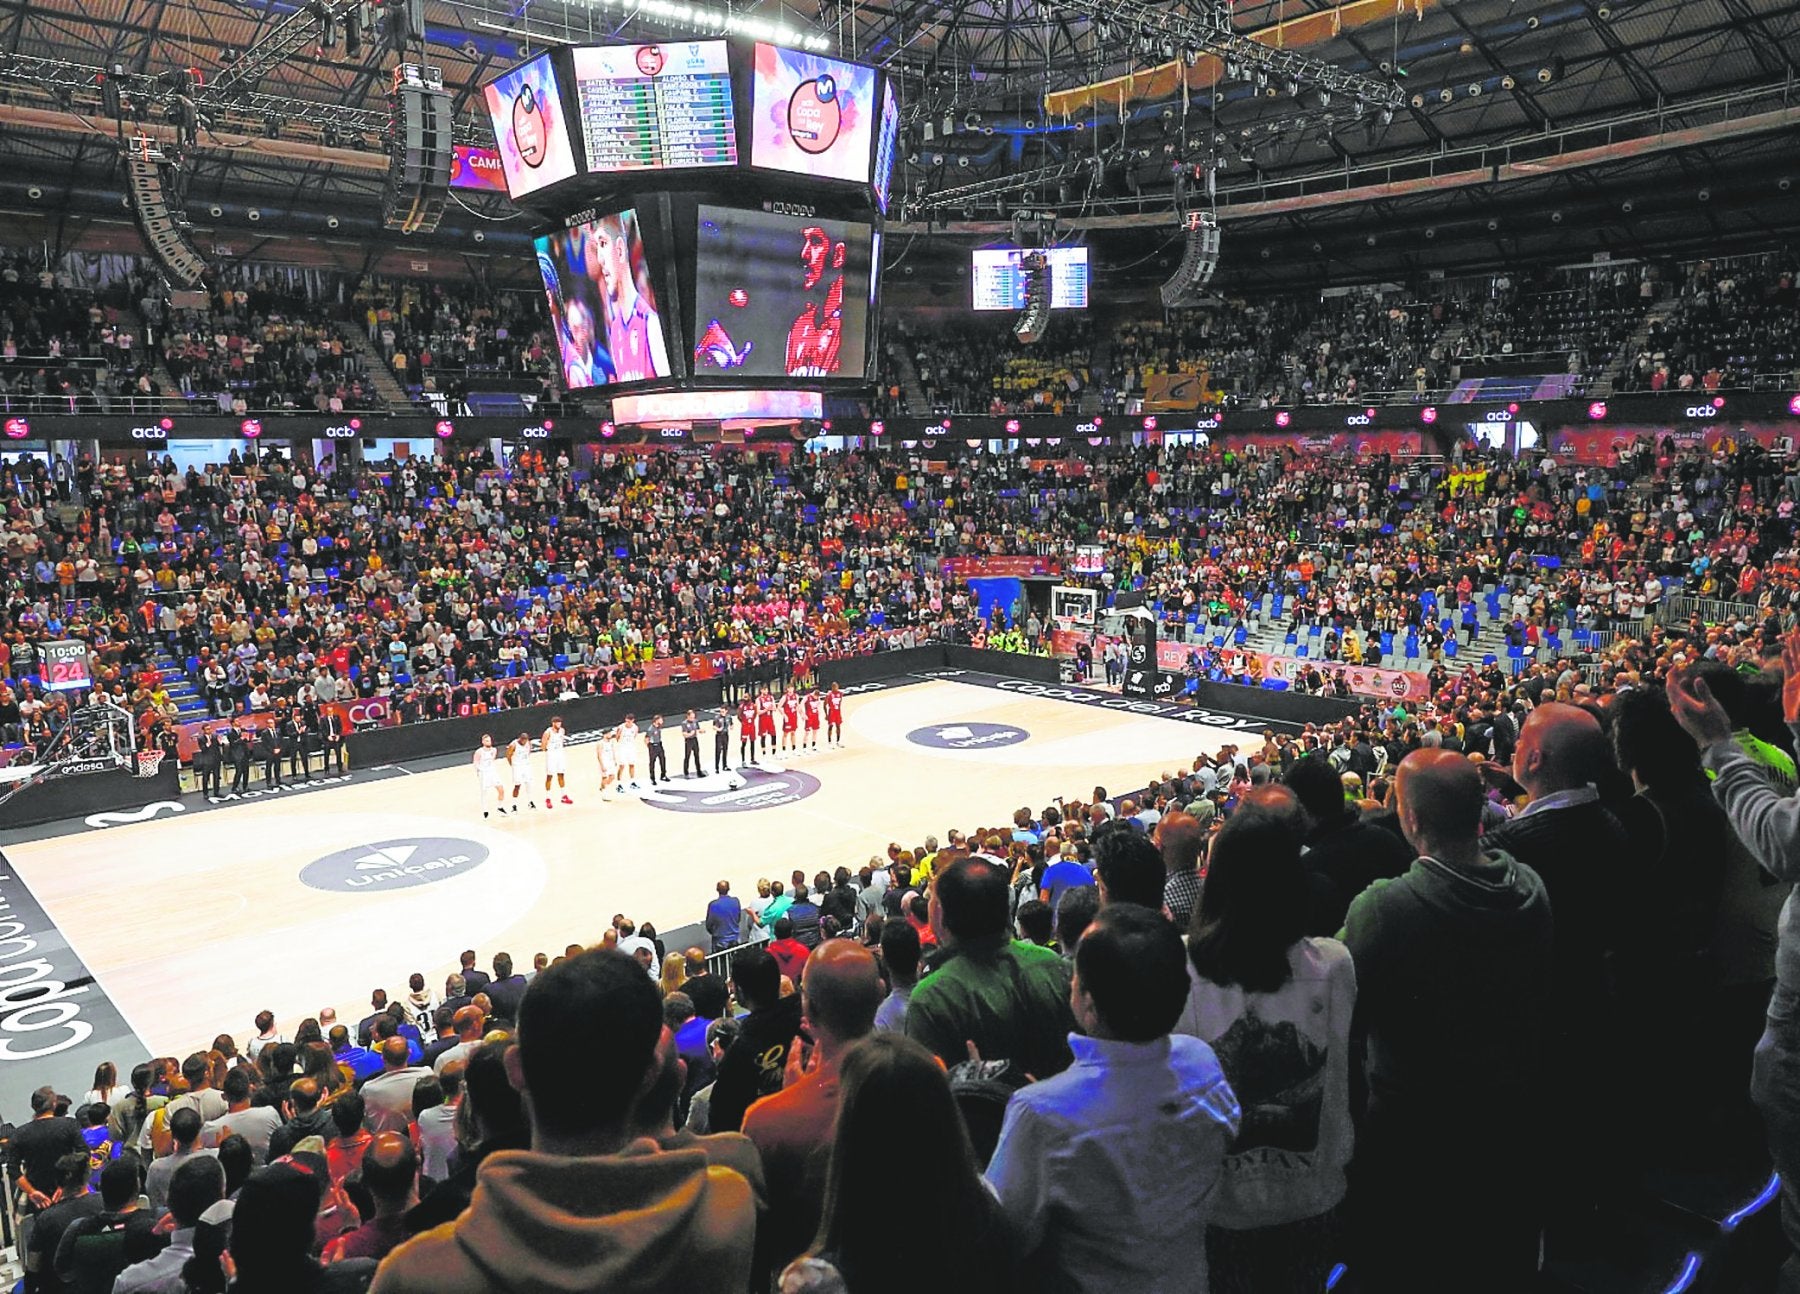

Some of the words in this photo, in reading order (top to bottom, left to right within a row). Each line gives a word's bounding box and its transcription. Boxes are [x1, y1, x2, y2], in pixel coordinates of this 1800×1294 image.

[1486, 410, 1512, 421] acb
[1686, 404, 1716, 418] acb
[1197, 418, 1218, 428] acb
[1347, 415, 1370, 425] acb
[132, 426, 166, 438] acb
[326, 426, 355, 438] acb
[523, 427, 548, 438] acb
[925, 425, 946, 435] acb
[1076, 422, 1097, 432] acb
[50, 646, 85, 658] 10:00
[1164, 650, 1183, 662] REY
[52, 662, 83, 683] 24
[1154, 682, 1170, 693] acb
[996, 680, 1102, 702] Copa
[1100, 700, 1180, 716] del
[1172, 709, 1268, 730] Rey
[62, 760, 104, 774] endesa
[345, 854, 471, 888] Unicaja
